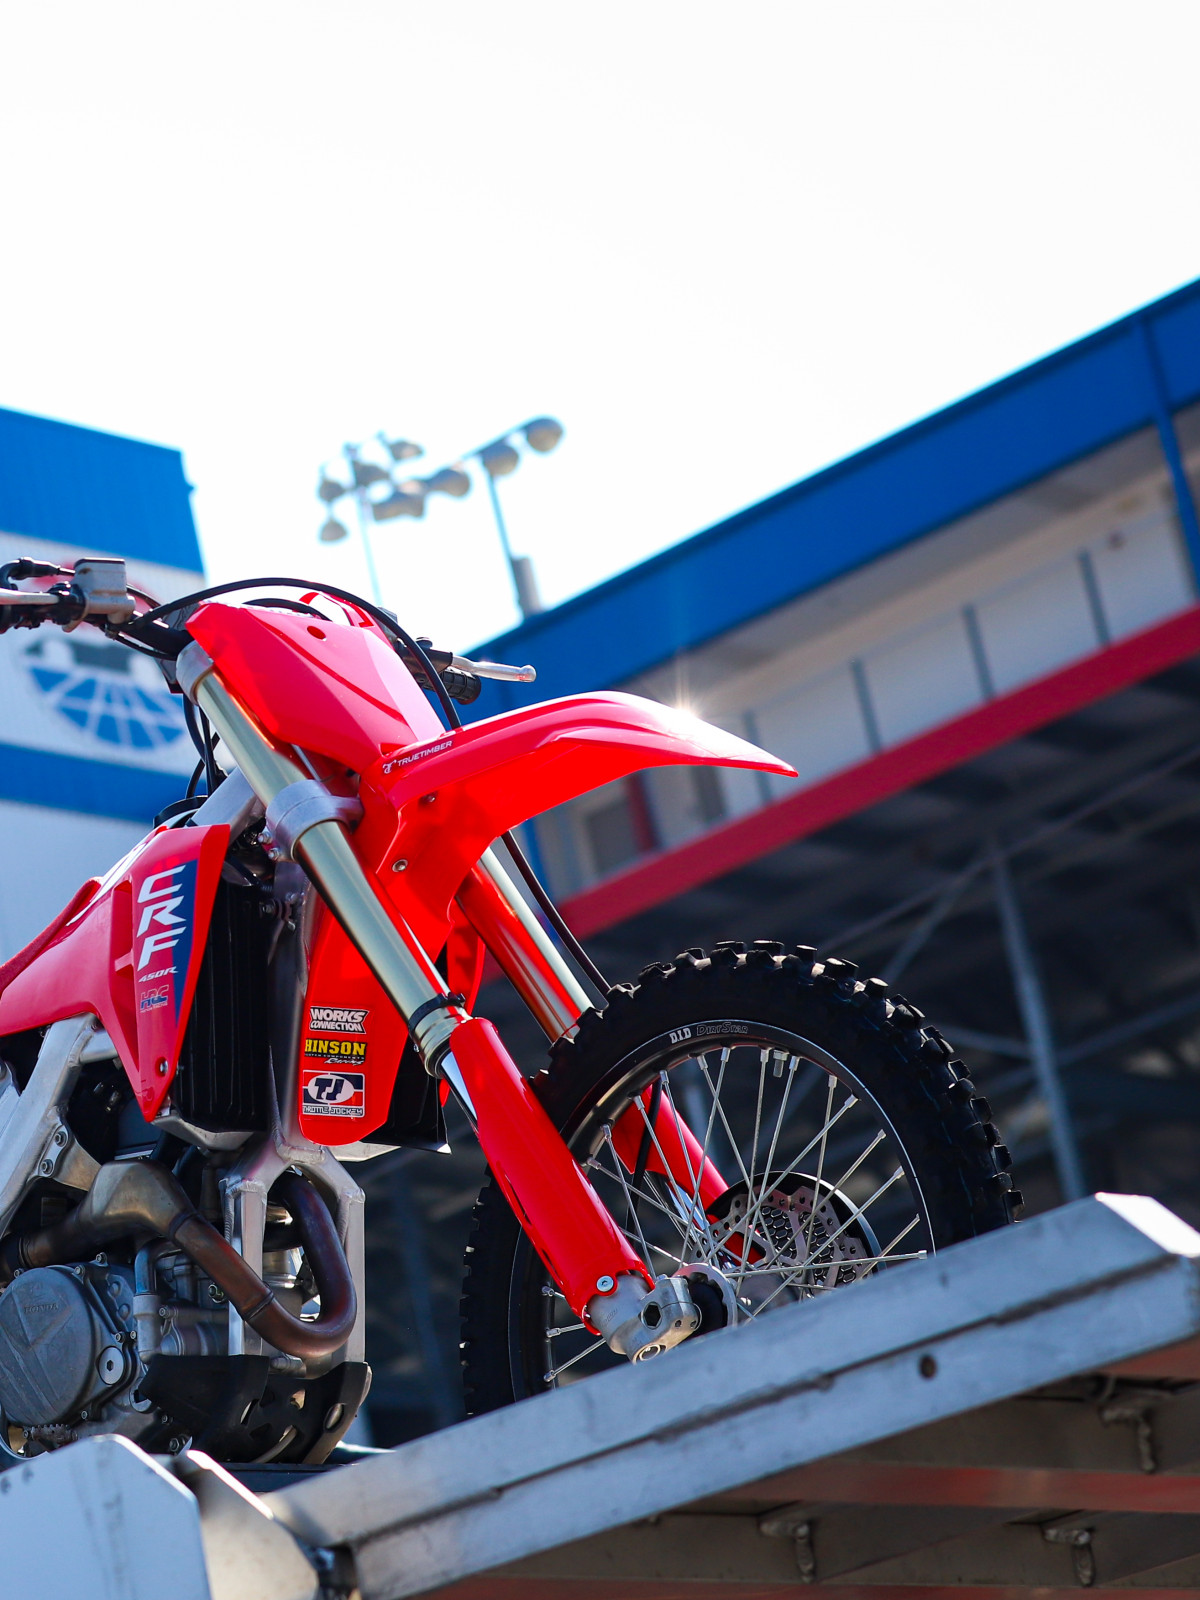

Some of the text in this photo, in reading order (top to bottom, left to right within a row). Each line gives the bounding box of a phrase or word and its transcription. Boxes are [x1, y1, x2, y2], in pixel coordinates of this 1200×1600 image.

[397, 741, 452, 766] TRUETIMBER
[136, 864, 187, 971] CRF
[138, 966, 179, 982] 450R
[310, 1008, 366, 1023] WORKS
[310, 1020, 363, 1032] CONNECTION
[304, 1039, 366, 1056] HINSON
[314, 1077, 345, 1101] TJ
